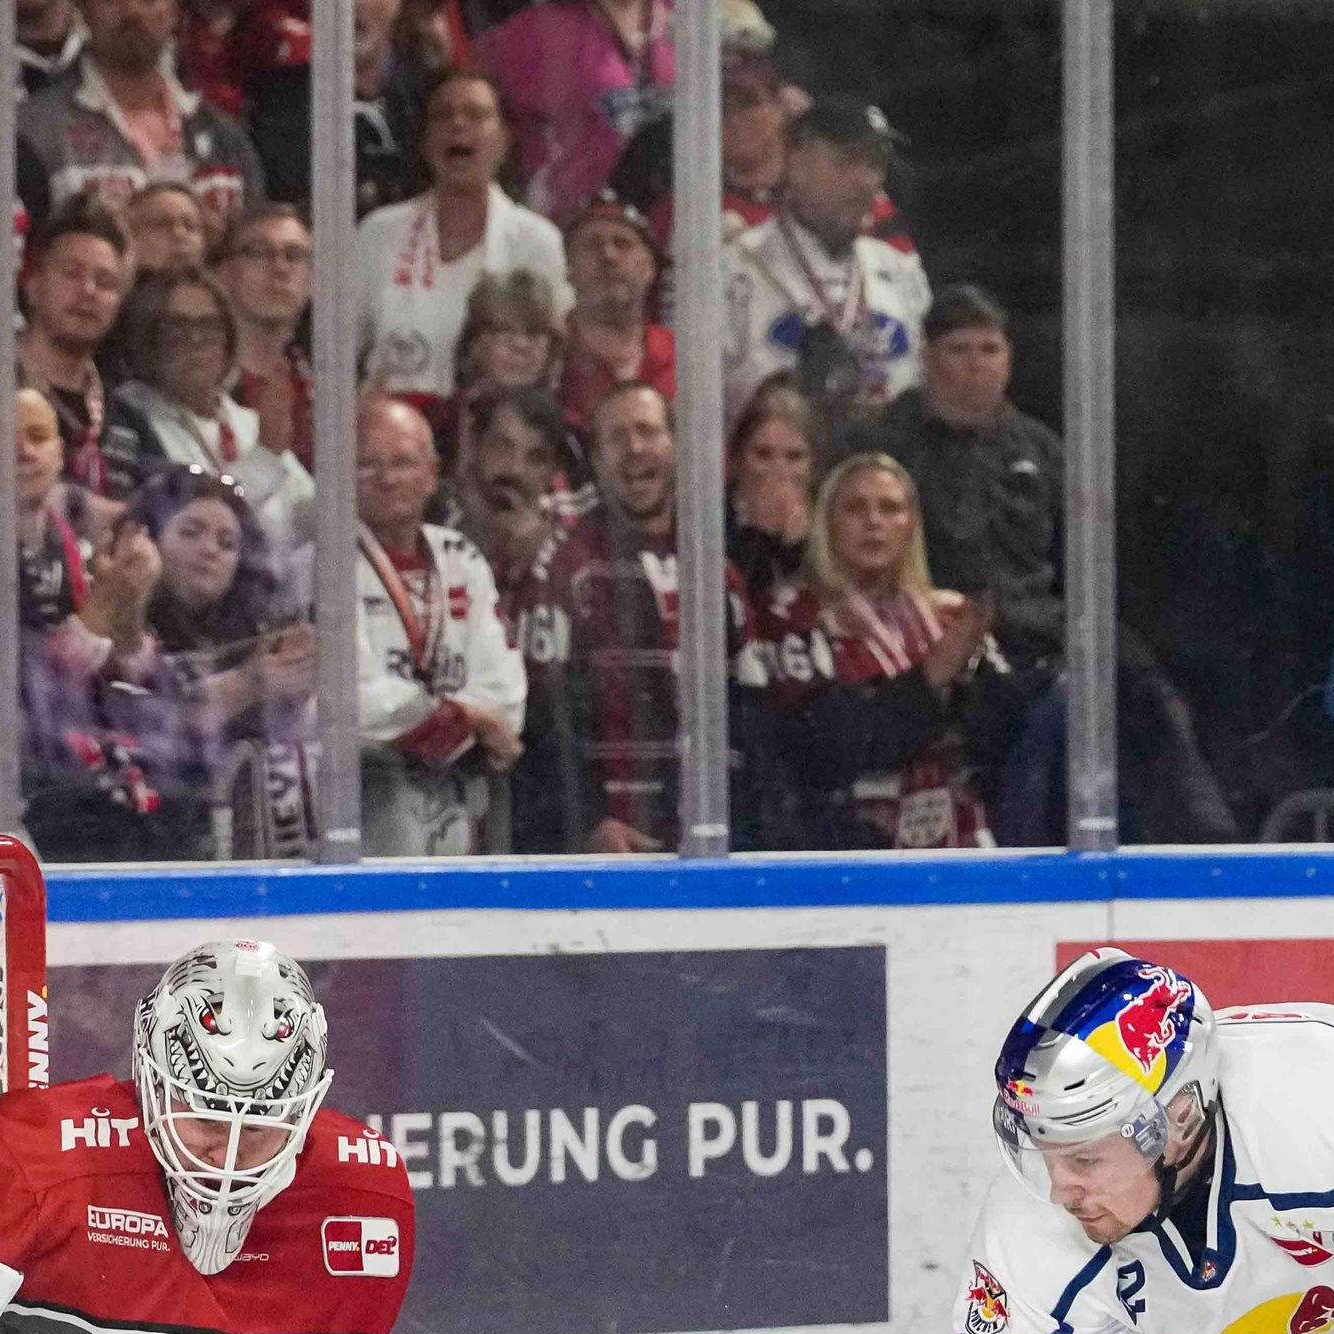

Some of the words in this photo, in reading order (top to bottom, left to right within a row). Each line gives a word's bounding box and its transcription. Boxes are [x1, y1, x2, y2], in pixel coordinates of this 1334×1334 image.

[61, 1107, 139, 1151] HIT
[688, 1098, 874, 1178] PUR.
[87, 1205, 168, 1238] EUROPA
[87, 1231, 149, 1250] VERSICHERUNG
